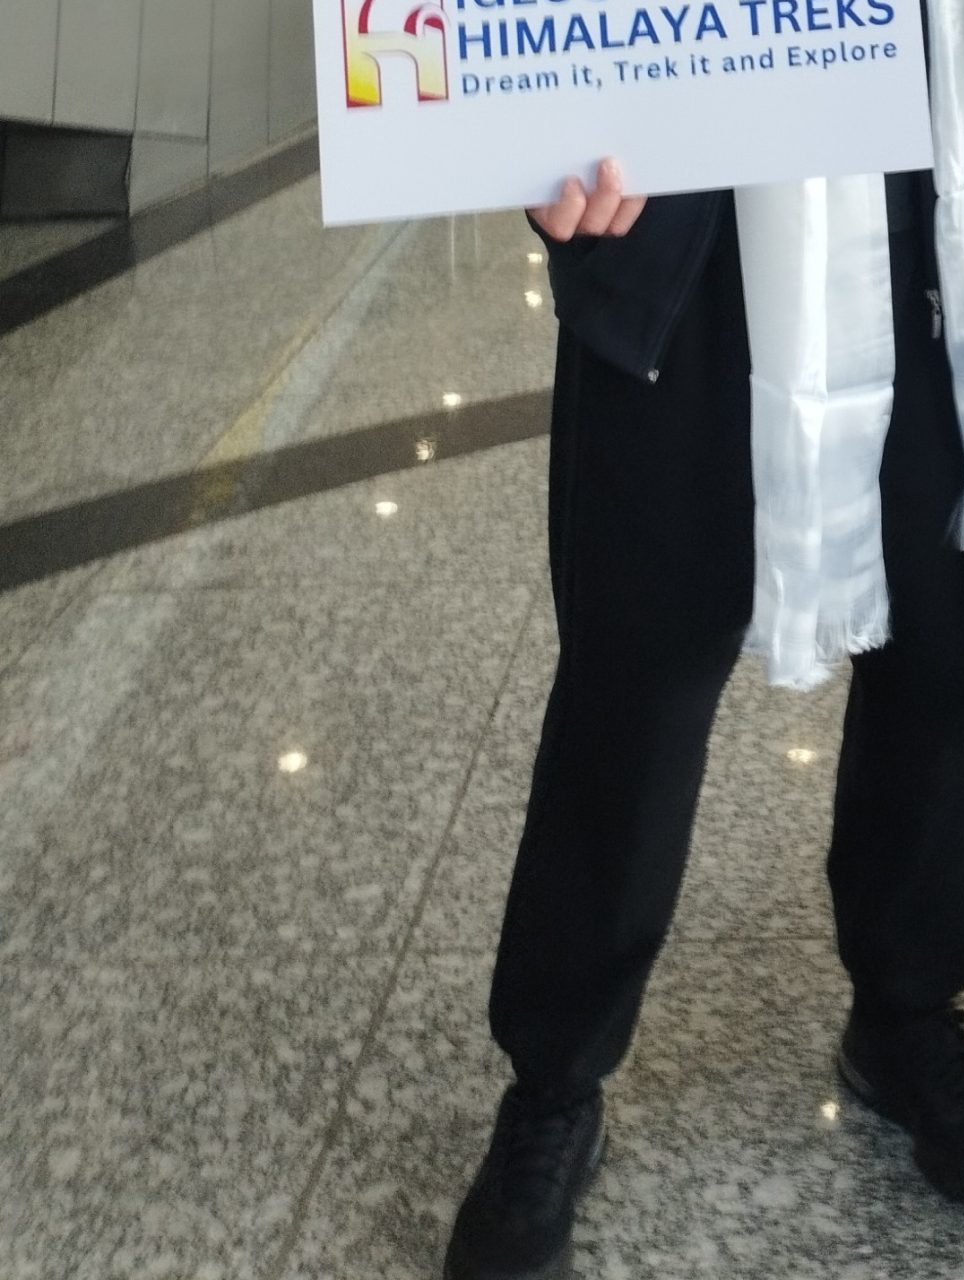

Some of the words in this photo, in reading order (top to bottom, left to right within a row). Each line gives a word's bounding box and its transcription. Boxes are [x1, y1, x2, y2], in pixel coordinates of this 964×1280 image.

[457, 3, 728, 61] HIMALAYA
[462, 72, 559, 96] Dream
[571, 65, 603, 91] it,
[614, 57, 678, 82] Trek
[690, 55, 712, 78] it
[722, 49, 775, 72] and
[787, 39, 898, 71] Explore
